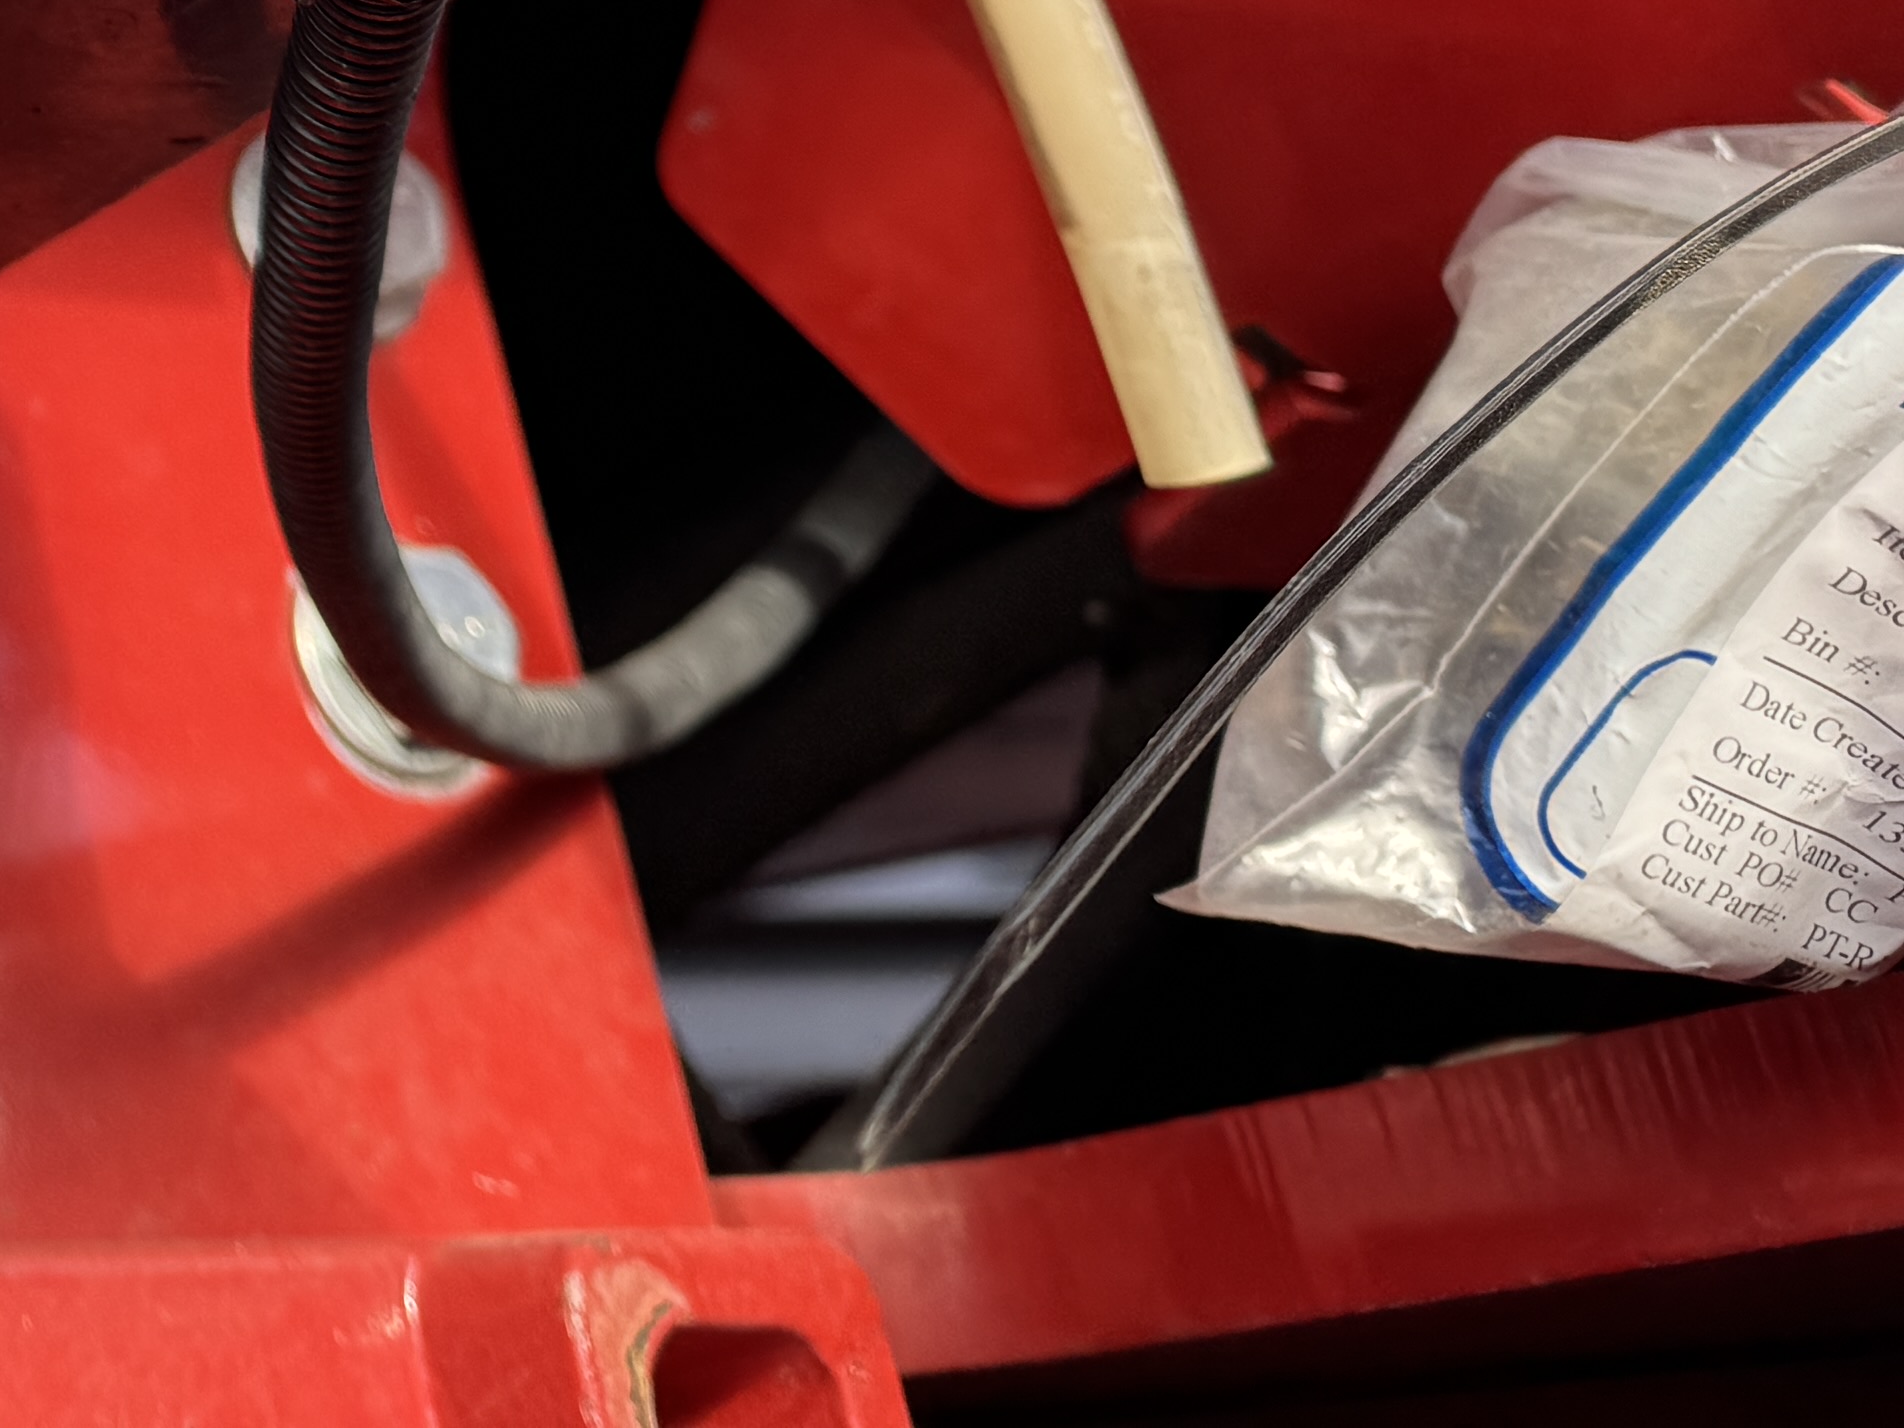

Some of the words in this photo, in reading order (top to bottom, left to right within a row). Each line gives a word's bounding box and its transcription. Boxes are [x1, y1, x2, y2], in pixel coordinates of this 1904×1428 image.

[1781, 616, 1841, 664] Bin
[1844, 655, 1881, 686] #:
[1740, 680, 1808, 731] Date
[1712, 736, 1796, 790] Order
[1799, 774, 1828, 806] #:
[1661, 818, 1728, 866] Cust
[1735, 851, 1800, 894] PO#
[1825, 887, 1880, 924] CC
[1678, 784, 1745, 837] Ship
[1750, 819, 1779, 848] to
[1780, 828, 1871, 887] Name:
[1640, 853, 1707, 899] Cust
[1705, 880, 1788, 934] Part#:
